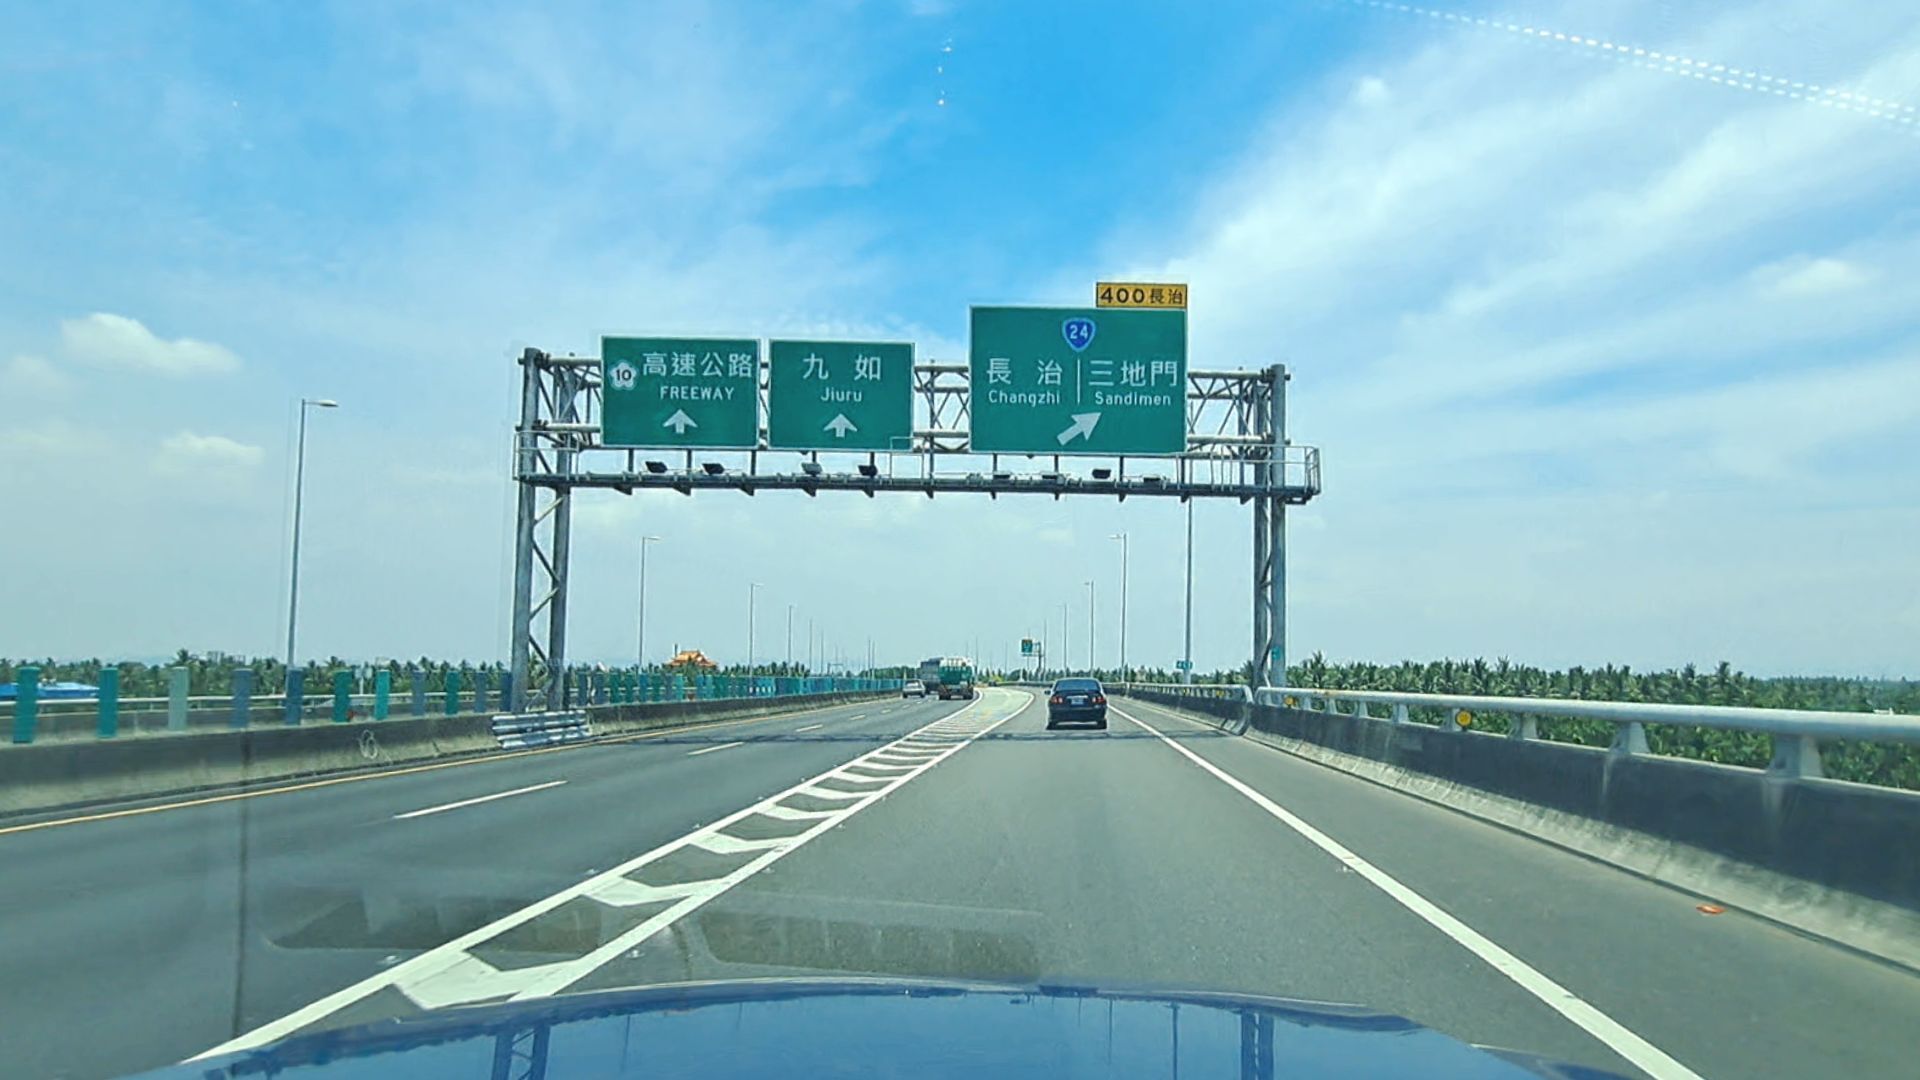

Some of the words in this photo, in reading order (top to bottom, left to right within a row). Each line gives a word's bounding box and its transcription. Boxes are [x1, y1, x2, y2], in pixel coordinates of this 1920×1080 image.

[1069, 324, 1089, 340] 24
[642, 351, 753, 379] 高速公路
[615, 369, 632, 382] 10
[1088, 360, 1178, 387] 三地門
[659, 386, 735, 401] FREEWAY
[820, 387, 863, 403] Jiuru
[988, 390, 1060, 407] Changzhi
[1095, 391, 1172, 406] Sandimen
